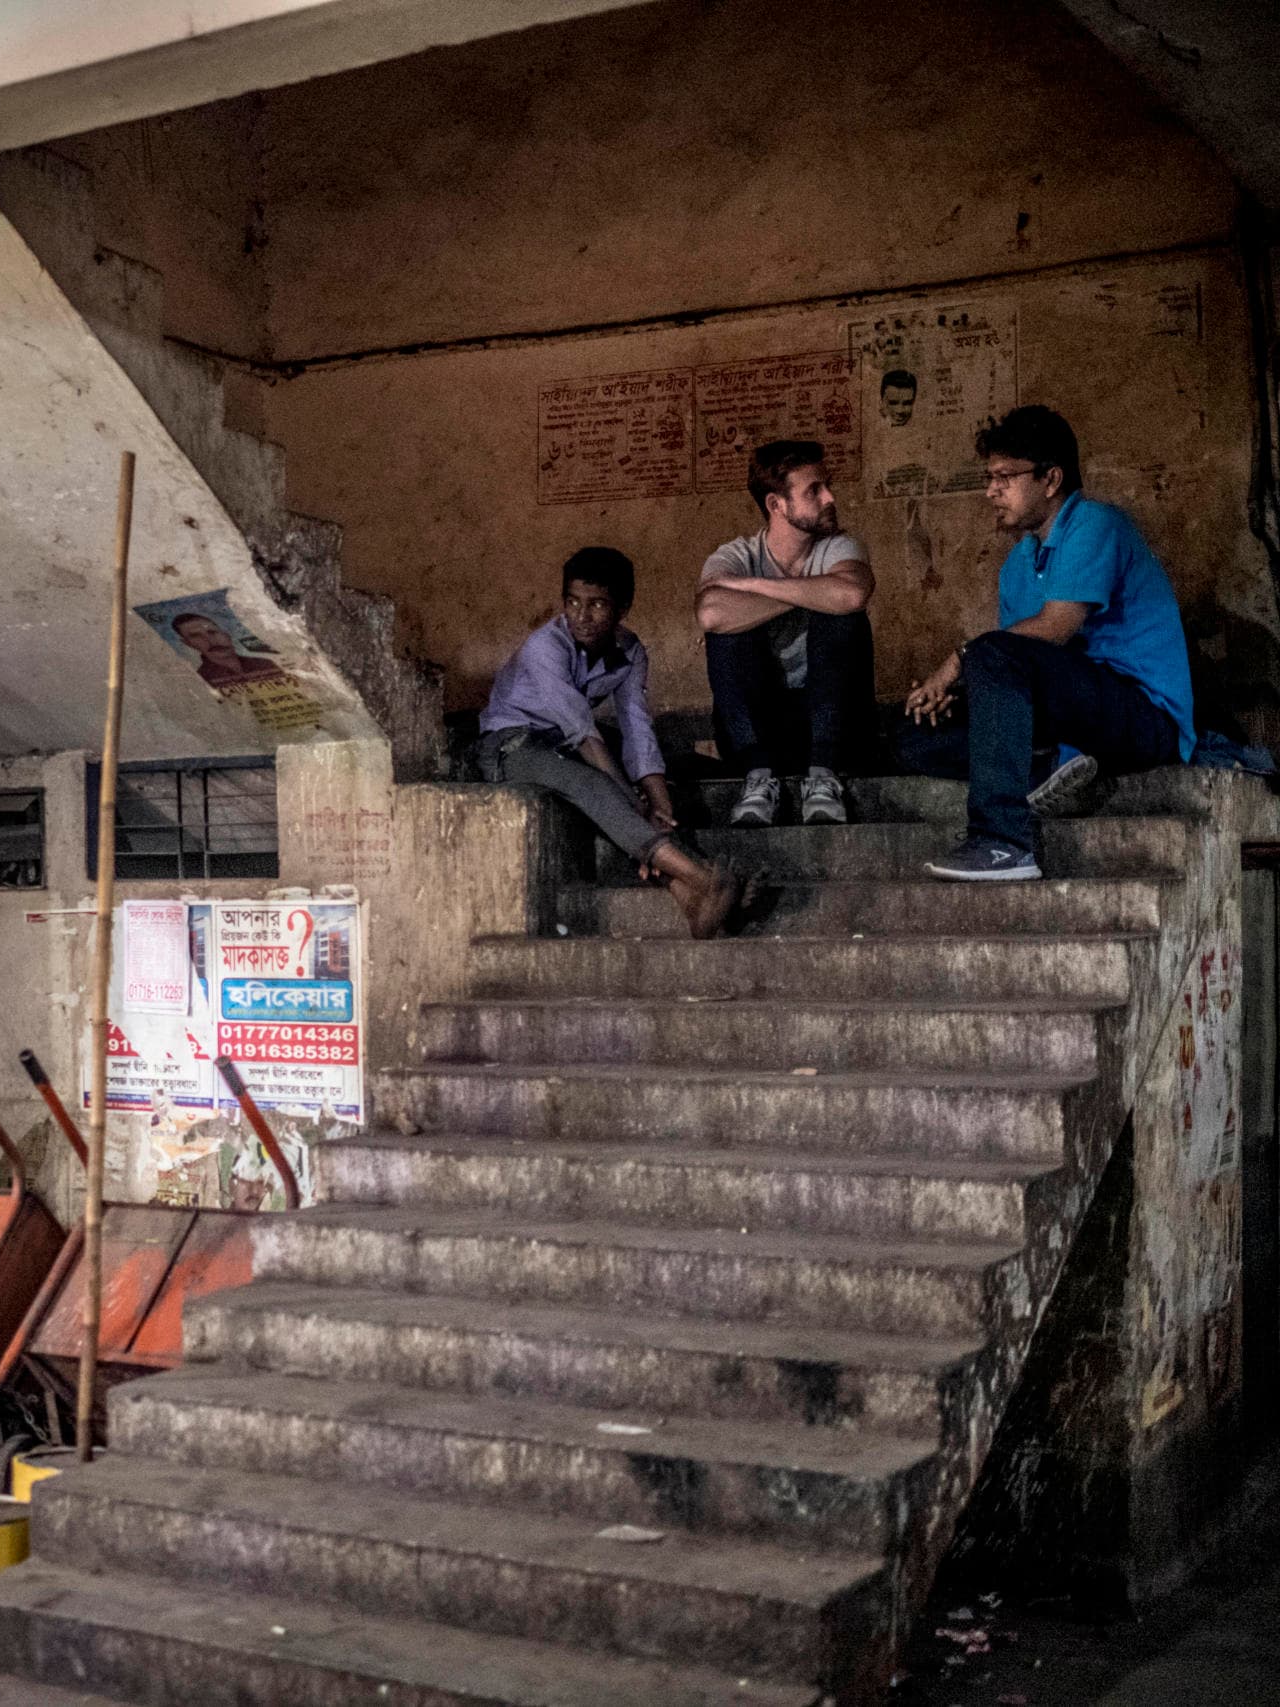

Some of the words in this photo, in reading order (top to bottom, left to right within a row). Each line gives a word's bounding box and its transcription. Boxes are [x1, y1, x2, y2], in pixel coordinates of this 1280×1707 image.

[220, 908, 282, 929] আপনার
[220, 929, 249, 942] প্রিয়জন
[251, 930, 268, 943] কেউ
[269, 930, 281, 941] কি
[286, 909, 314, 978] ?
[220, 944, 290, 973] মাদকাসক্ত
[226, 981, 350, 1010] হলিকেয়ার
[220, 1024, 355, 1042] 01777014346
[220, 1043, 355, 1061] 01916385382
